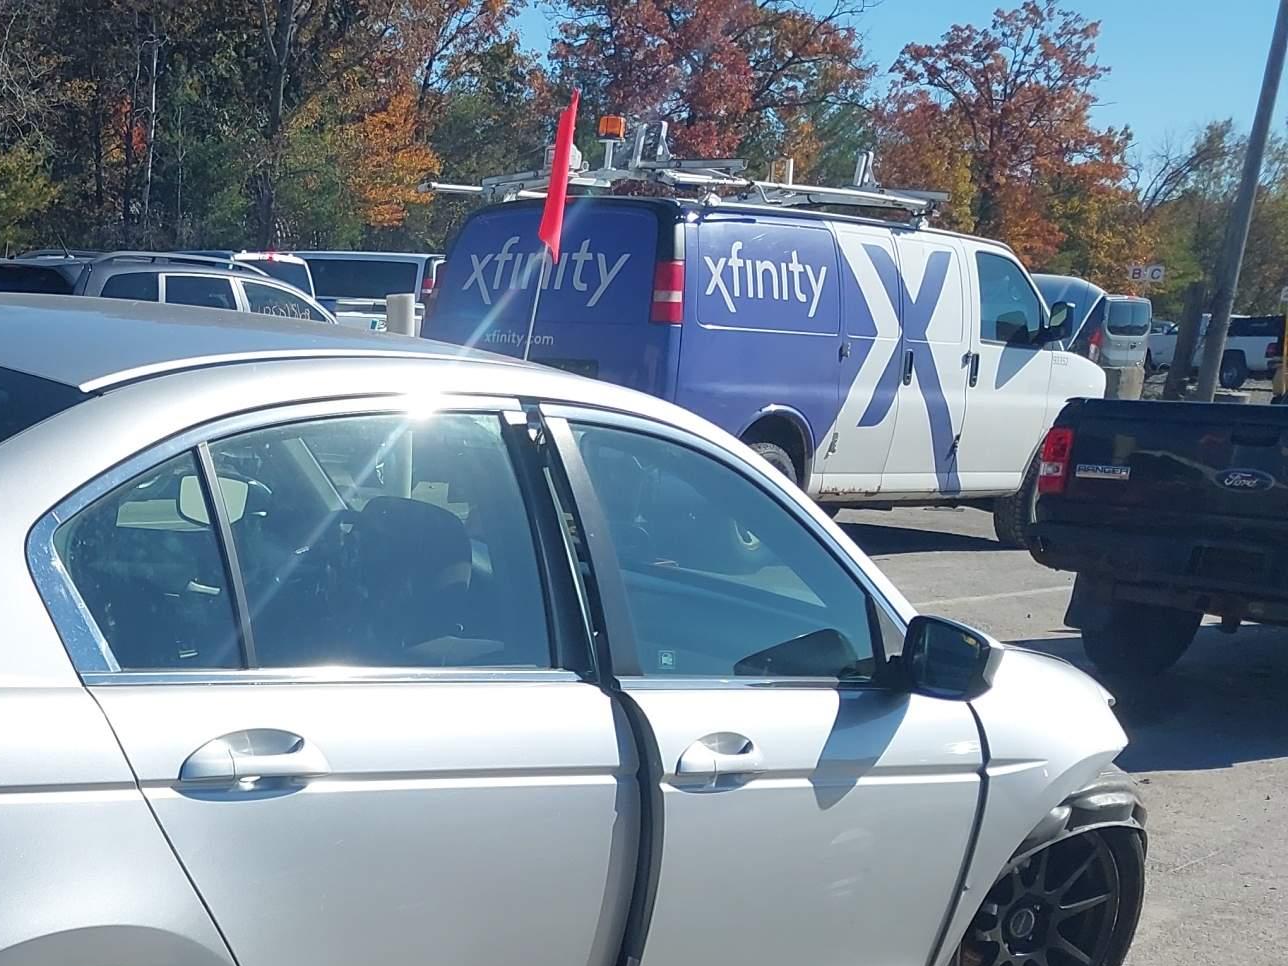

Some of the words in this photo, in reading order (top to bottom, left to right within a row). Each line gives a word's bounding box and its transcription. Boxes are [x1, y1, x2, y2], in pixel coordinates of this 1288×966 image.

[462, 236, 631, 307] xfinity
[1132, 268, 1142, 280] B
[1151, 268, 1161, 280] C
[703, 240, 827, 318] xfinity
[1077, 465, 1129, 476] RANGER
[1224, 472, 1258, 488] Ford
